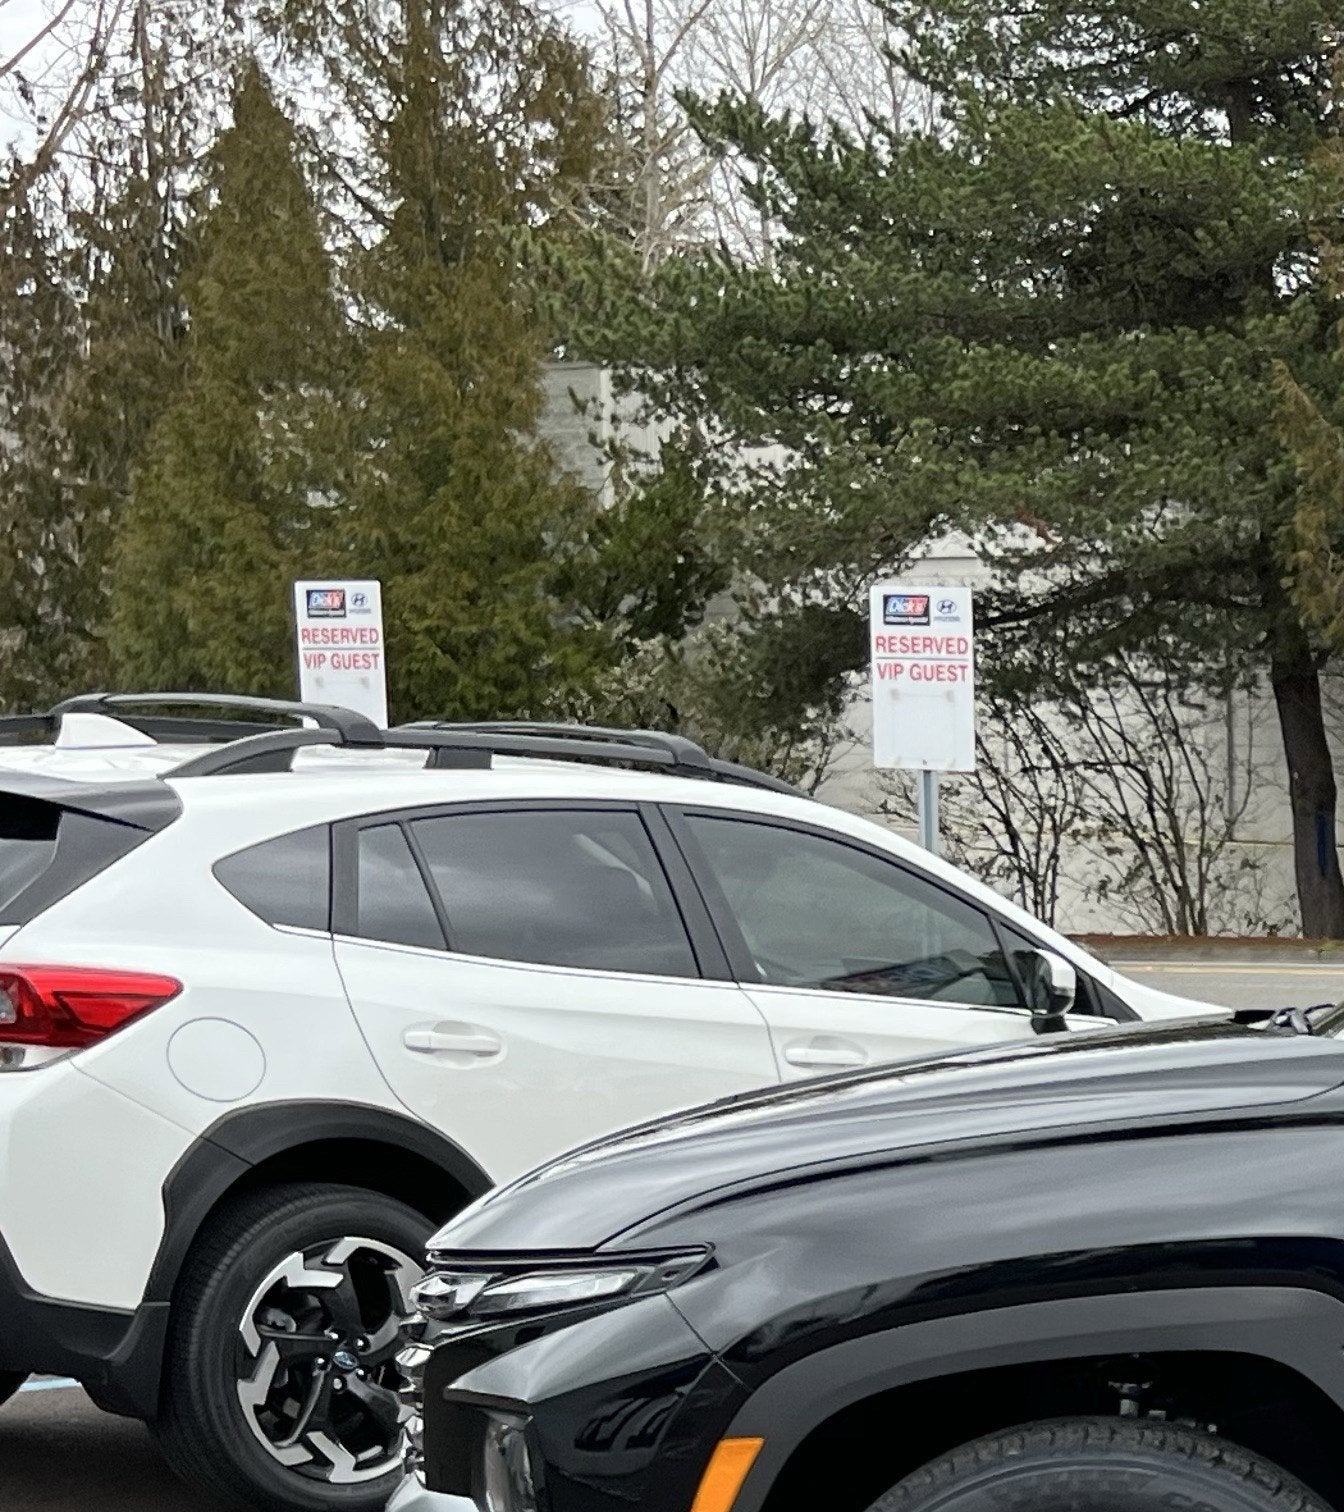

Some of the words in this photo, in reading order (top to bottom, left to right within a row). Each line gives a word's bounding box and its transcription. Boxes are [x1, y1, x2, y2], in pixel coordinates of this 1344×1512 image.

[301, 628, 380, 645] RESERVED
[875, 635, 969, 655] RESERVED
[303, 653, 326, 670] VIP
[330, 653, 380, 670] GUEST
[877, 663, 904, 681] VIP
[909, 663, 968, 682] GUEST
